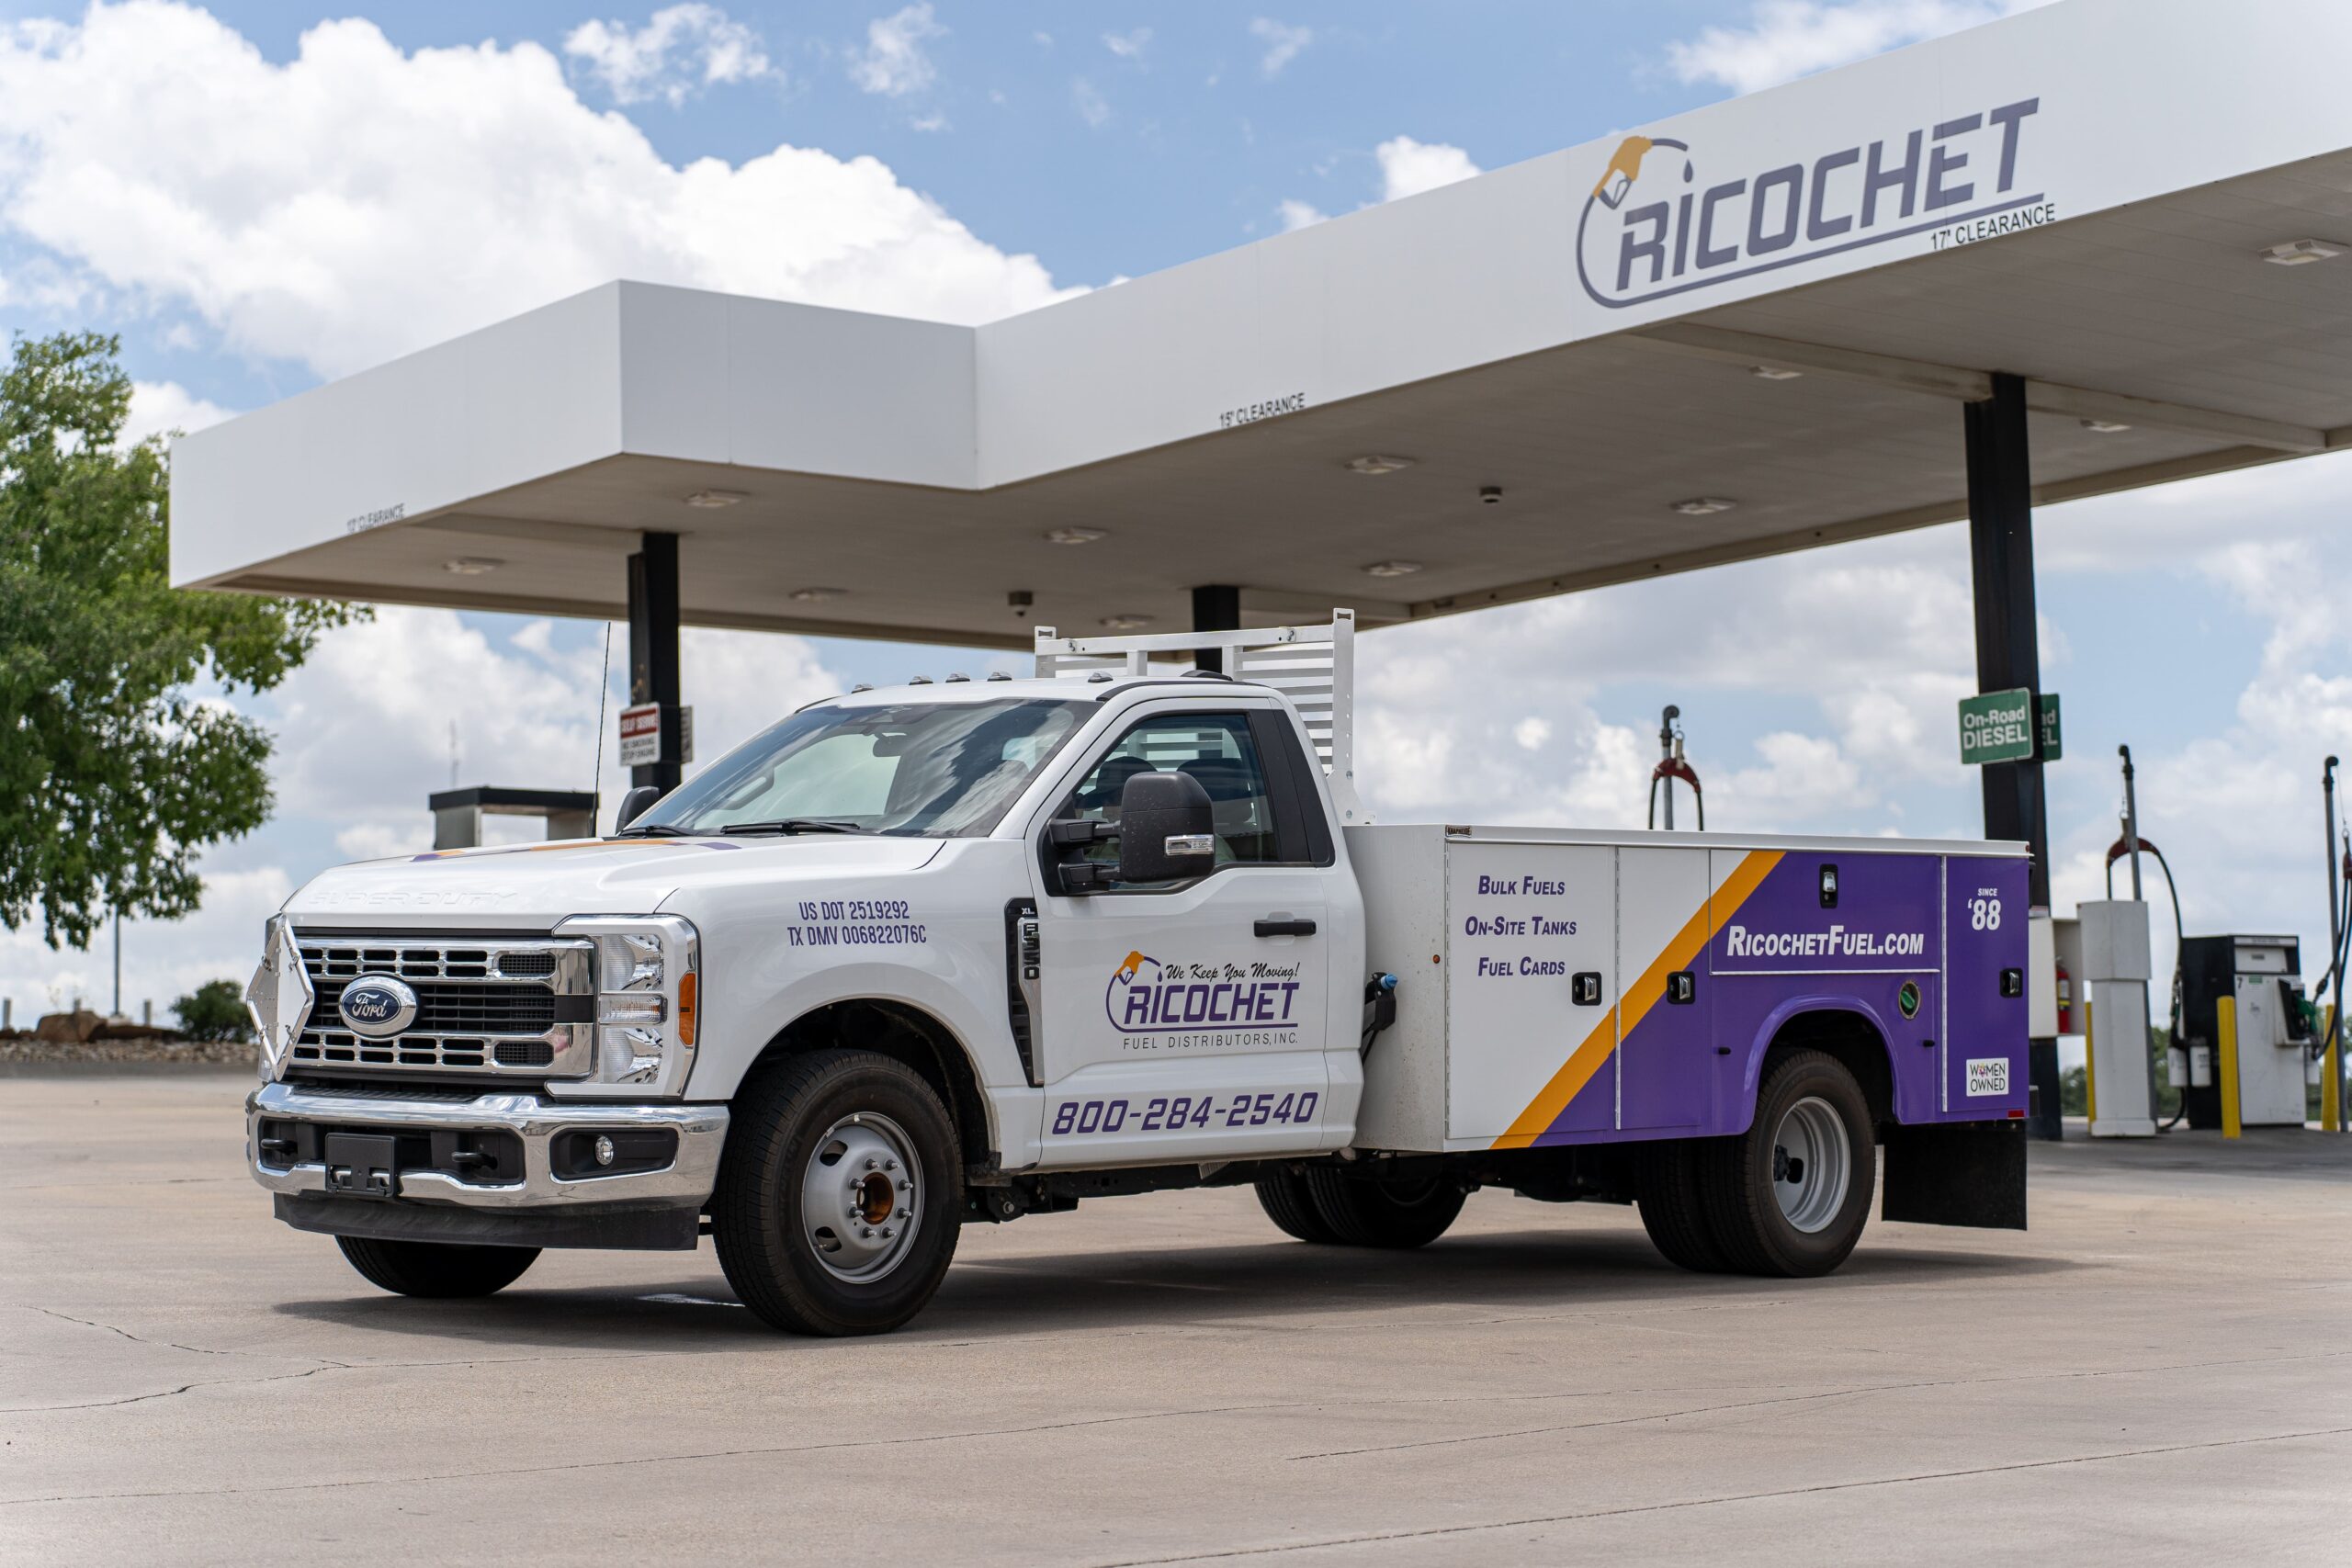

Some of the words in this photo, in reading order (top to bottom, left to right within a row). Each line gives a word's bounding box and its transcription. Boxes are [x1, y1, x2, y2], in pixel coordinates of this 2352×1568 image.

[1616, 97, 2040, 292] RICOCHET
[1930, 230, 1951, 250] 17'
[1955, 203, 2055, 244] CLEARANCE
[1236, 392, 1305, 423] CLEARANCE
[1963, 705, 2026, 728] On-Road
[1962, 724, 2029, 750] DIESEL
[1477, 875, 1517, 896] BULK
[1521, 875, 1566, 896] FUELS
[1977, 887, 1997, 897] SINCE
[798, 901, 818, 920] US
[820, 901, 845, 920] DOT
[848, 900, 910, 919] 2519292
[1021, 907, 1035, 915] XL
[1967, 898, 2001, 931] '88
[787, 926, 804, 946] TX
[807, 926, 838, 946] DMV
[842, 925, 927, 944] 006822076C
[1532, 916, 1577, 935] TANKS
[1166, 964, 1185, 979] We
[1189, 964, 1218, 982] Keep
[1223, 963, 1246, 983] You
[1250, 962, 1300, 981] Moving!
[1477, 956, 1514, 976] FUEL
[1520, 956, 1566, 976] CARDS
[352, 992, 388, 1018] Ford
[1124, 982, 1300, 1024] RICOCHET
[1123, 1037, 1158, 1050] FUEL
[1970, 1077, 2006, 1092] OWNED
[1052, 1092, 1318, 1134] 800-284-2540
